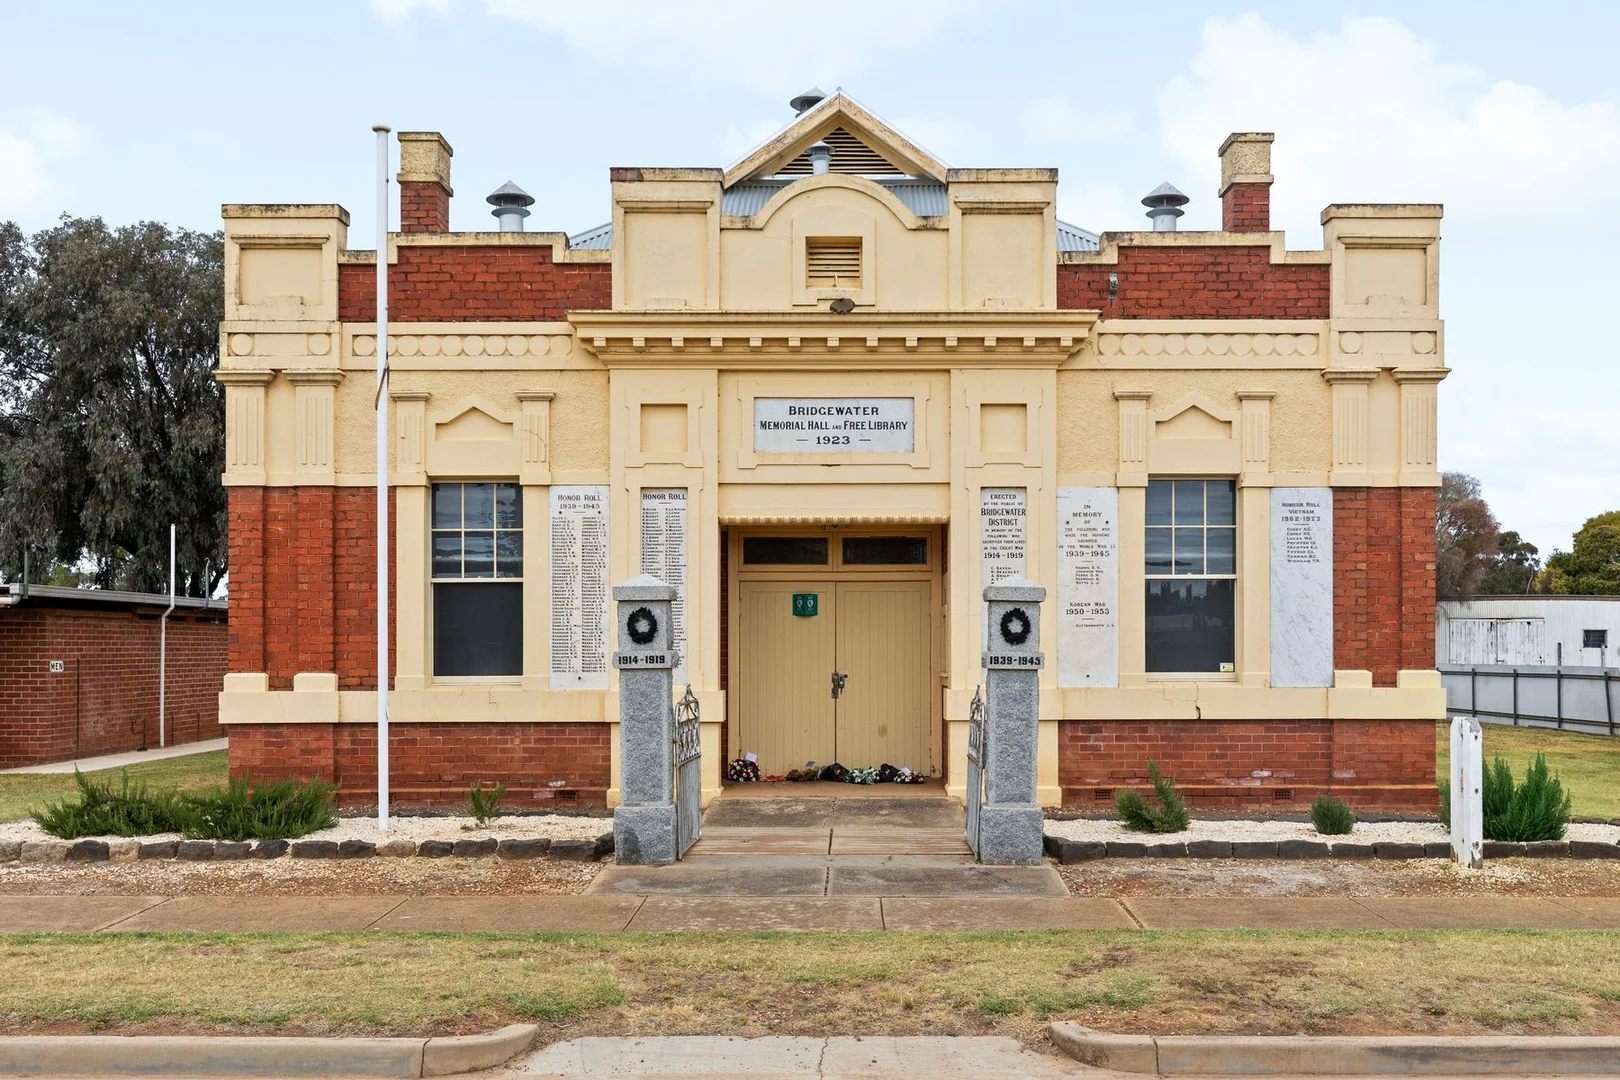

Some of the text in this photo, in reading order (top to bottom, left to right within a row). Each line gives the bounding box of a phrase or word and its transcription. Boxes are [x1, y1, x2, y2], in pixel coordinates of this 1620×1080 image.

[788, 406, 879, 416] BRIDGEWATER
[760, 420, 806, 430] MEMORIAL
[808, 420, 830, 430] HALL
[843, 420, 866, 430] FREE
[868, 420, 908, 430] LIBRARY
[816, 435, 851, 445] 1923
[981, 508, 1026, 516] BRIDGEWATER
[988, 518, 1018, 526] DISTRICT
[618, 655, 665, 665] 1914-1919
[989, 656, 1041, 665] 1939-1945
[51, 663, 63, 671] MEN
